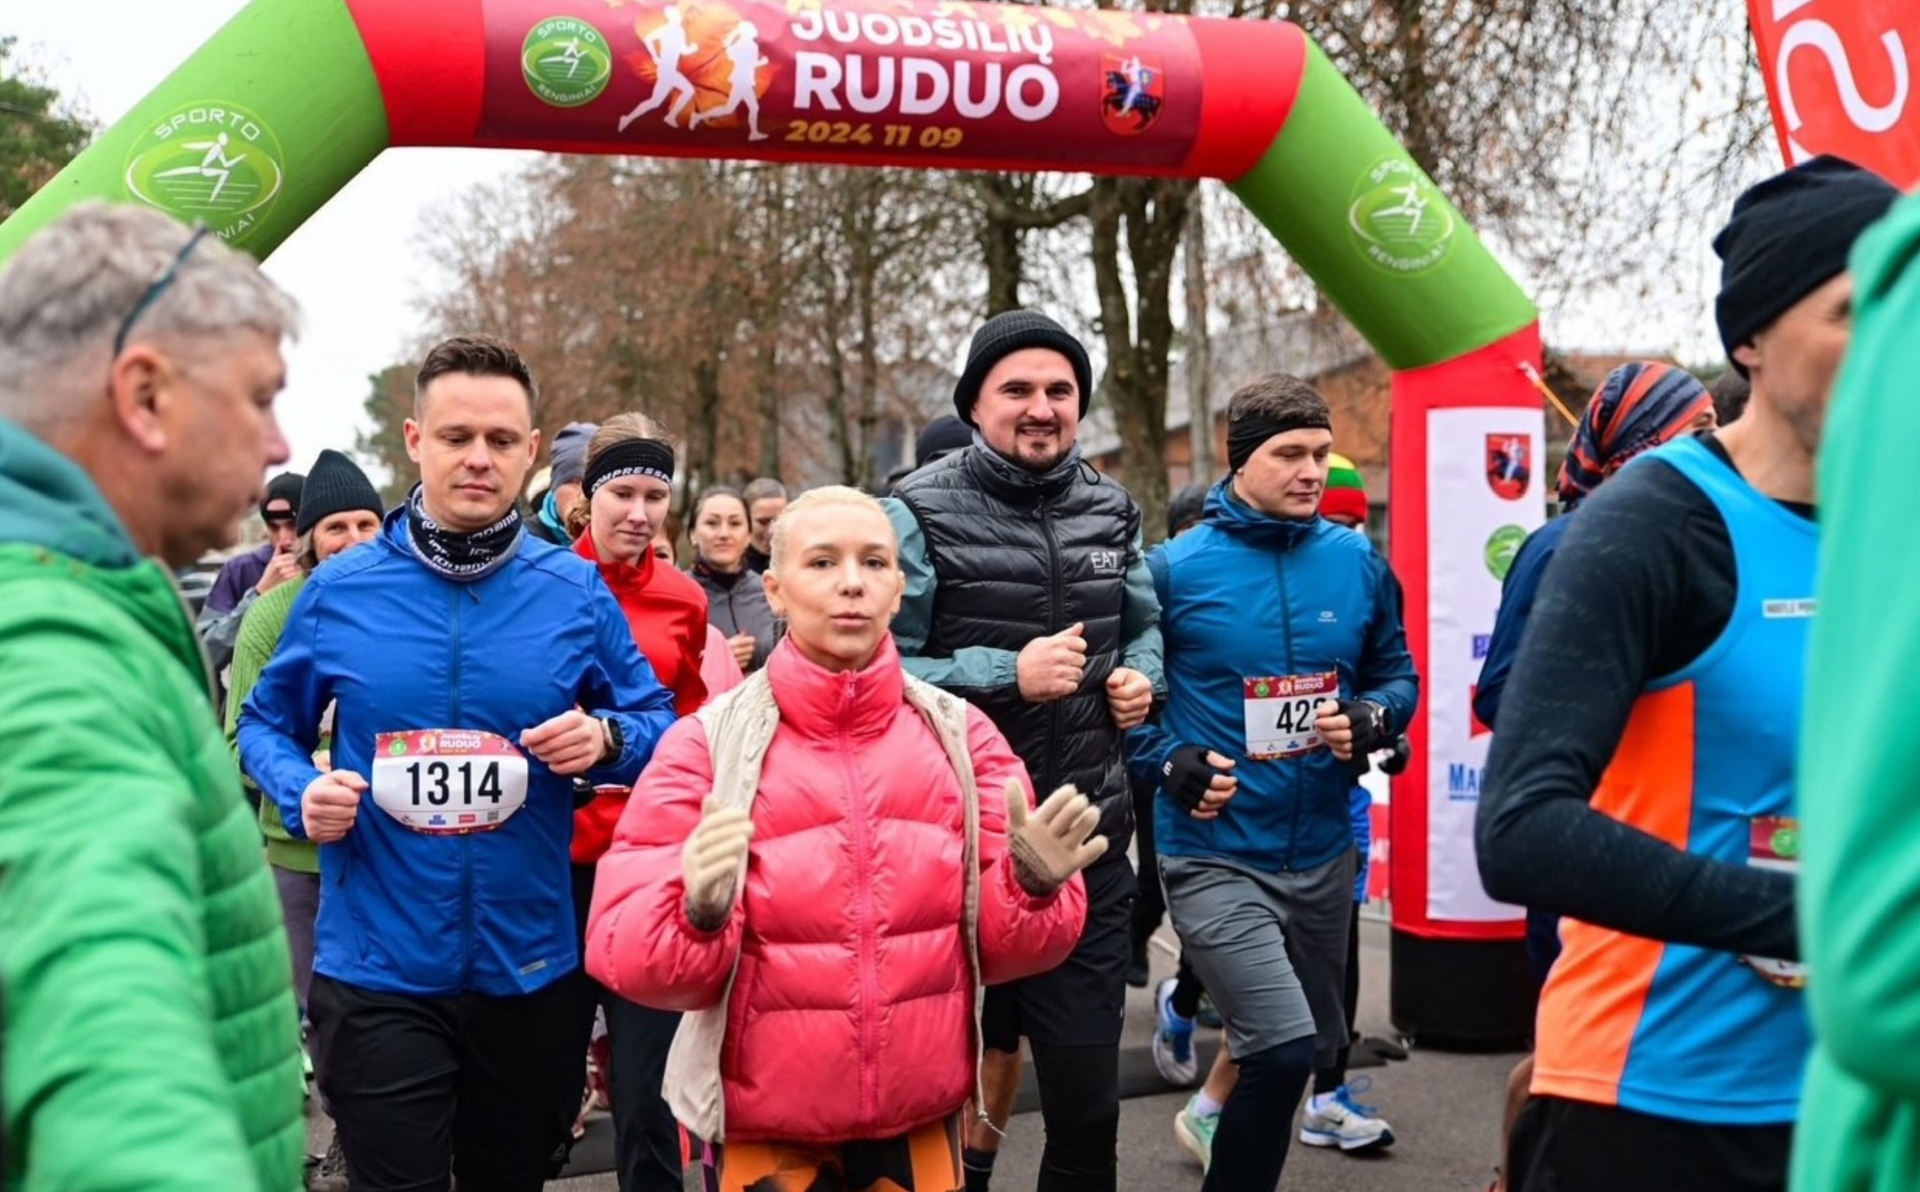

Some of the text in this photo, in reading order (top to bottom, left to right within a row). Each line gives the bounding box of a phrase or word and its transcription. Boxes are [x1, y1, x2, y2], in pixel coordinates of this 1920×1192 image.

[537, 20, 598, 43] SPORTO
[793, 50, 1060, 121] RUDUO
[154, 107, 260, 141] SPORTO
[785, 119, 963, 149] 2024 11 09
[406, 760, 503, 805] 1314
